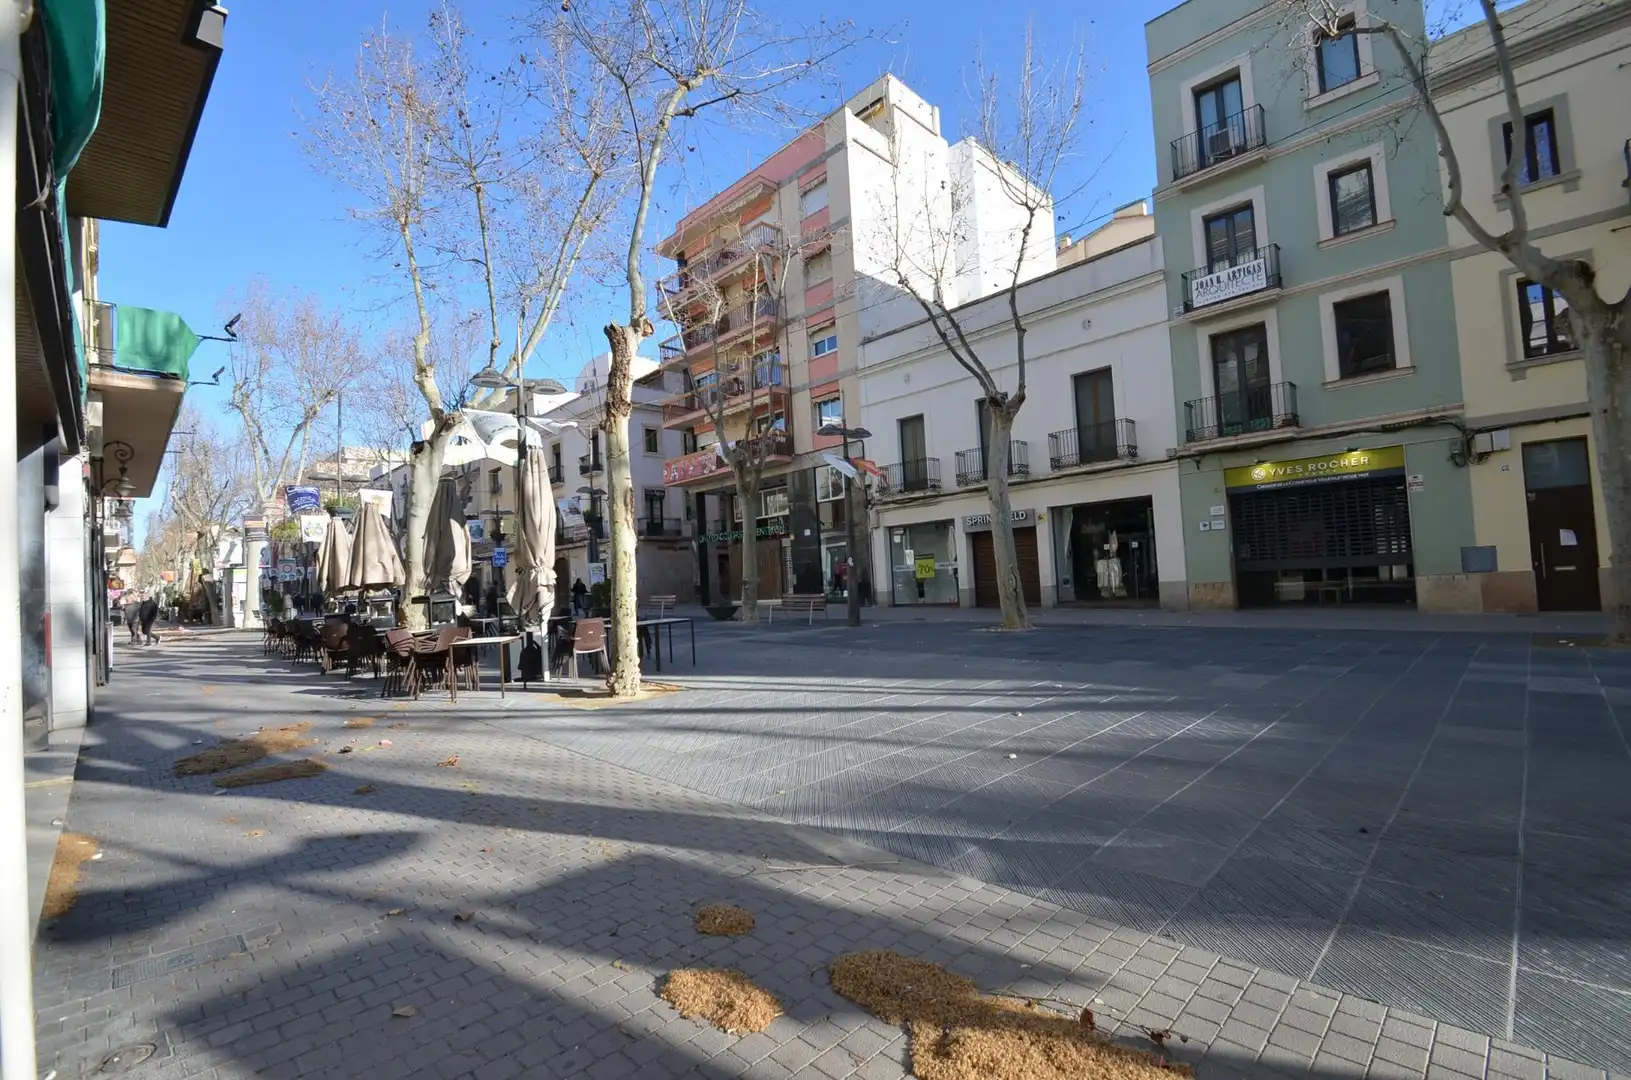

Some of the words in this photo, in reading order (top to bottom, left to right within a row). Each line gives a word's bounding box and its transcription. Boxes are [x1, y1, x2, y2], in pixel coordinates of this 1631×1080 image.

[1195, 277, 1214, 291] JOAN
[1226, 262, 1263, 281] ARTIGAS
[1196, 274, 1263, 298] ARQUITECTE
[1269, 465, 1303, 476] YVES
[1308, 456, 1370, 472] ROCHER
[966, 511, 1027, 526] SPRINELD
